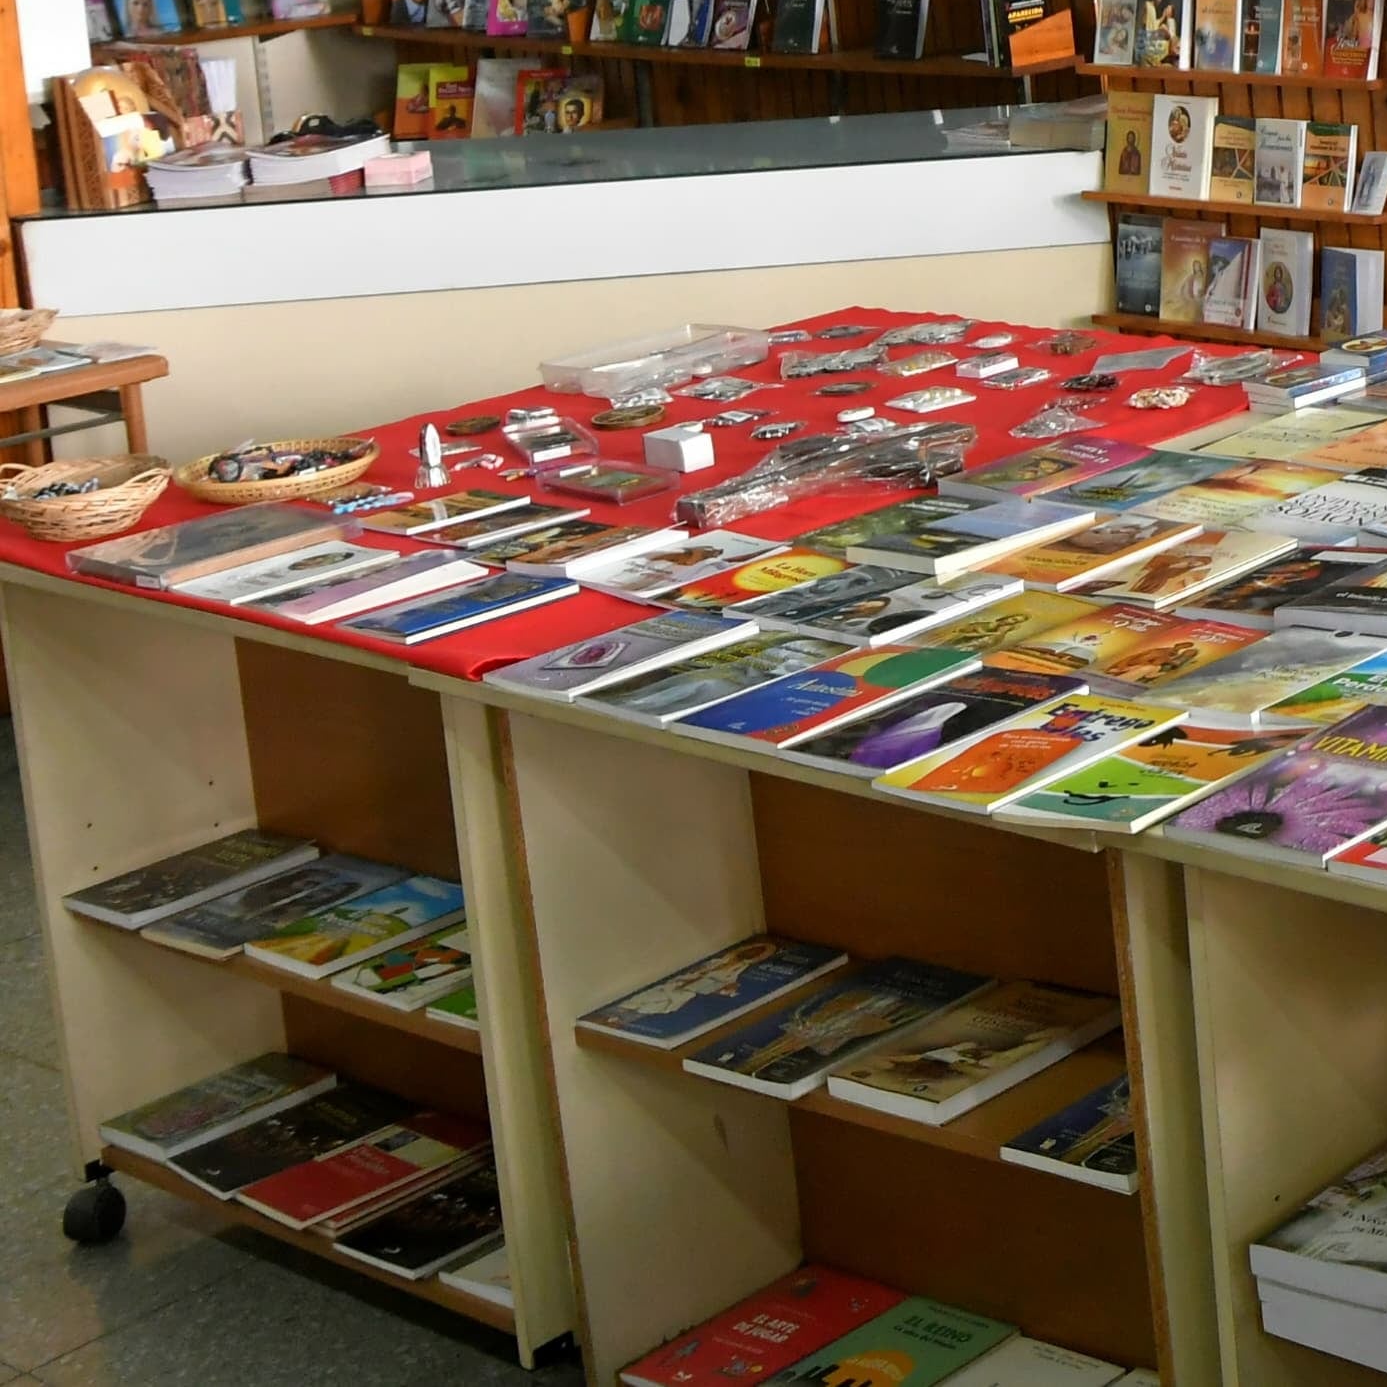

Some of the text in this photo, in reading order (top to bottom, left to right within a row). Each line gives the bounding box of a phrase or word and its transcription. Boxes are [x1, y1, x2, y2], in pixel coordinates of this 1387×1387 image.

[1368, 675, 1384, 684] El
[1046, 702, 1156, 732] Entrego
[768, 1317, 800, 1333] ARTE
